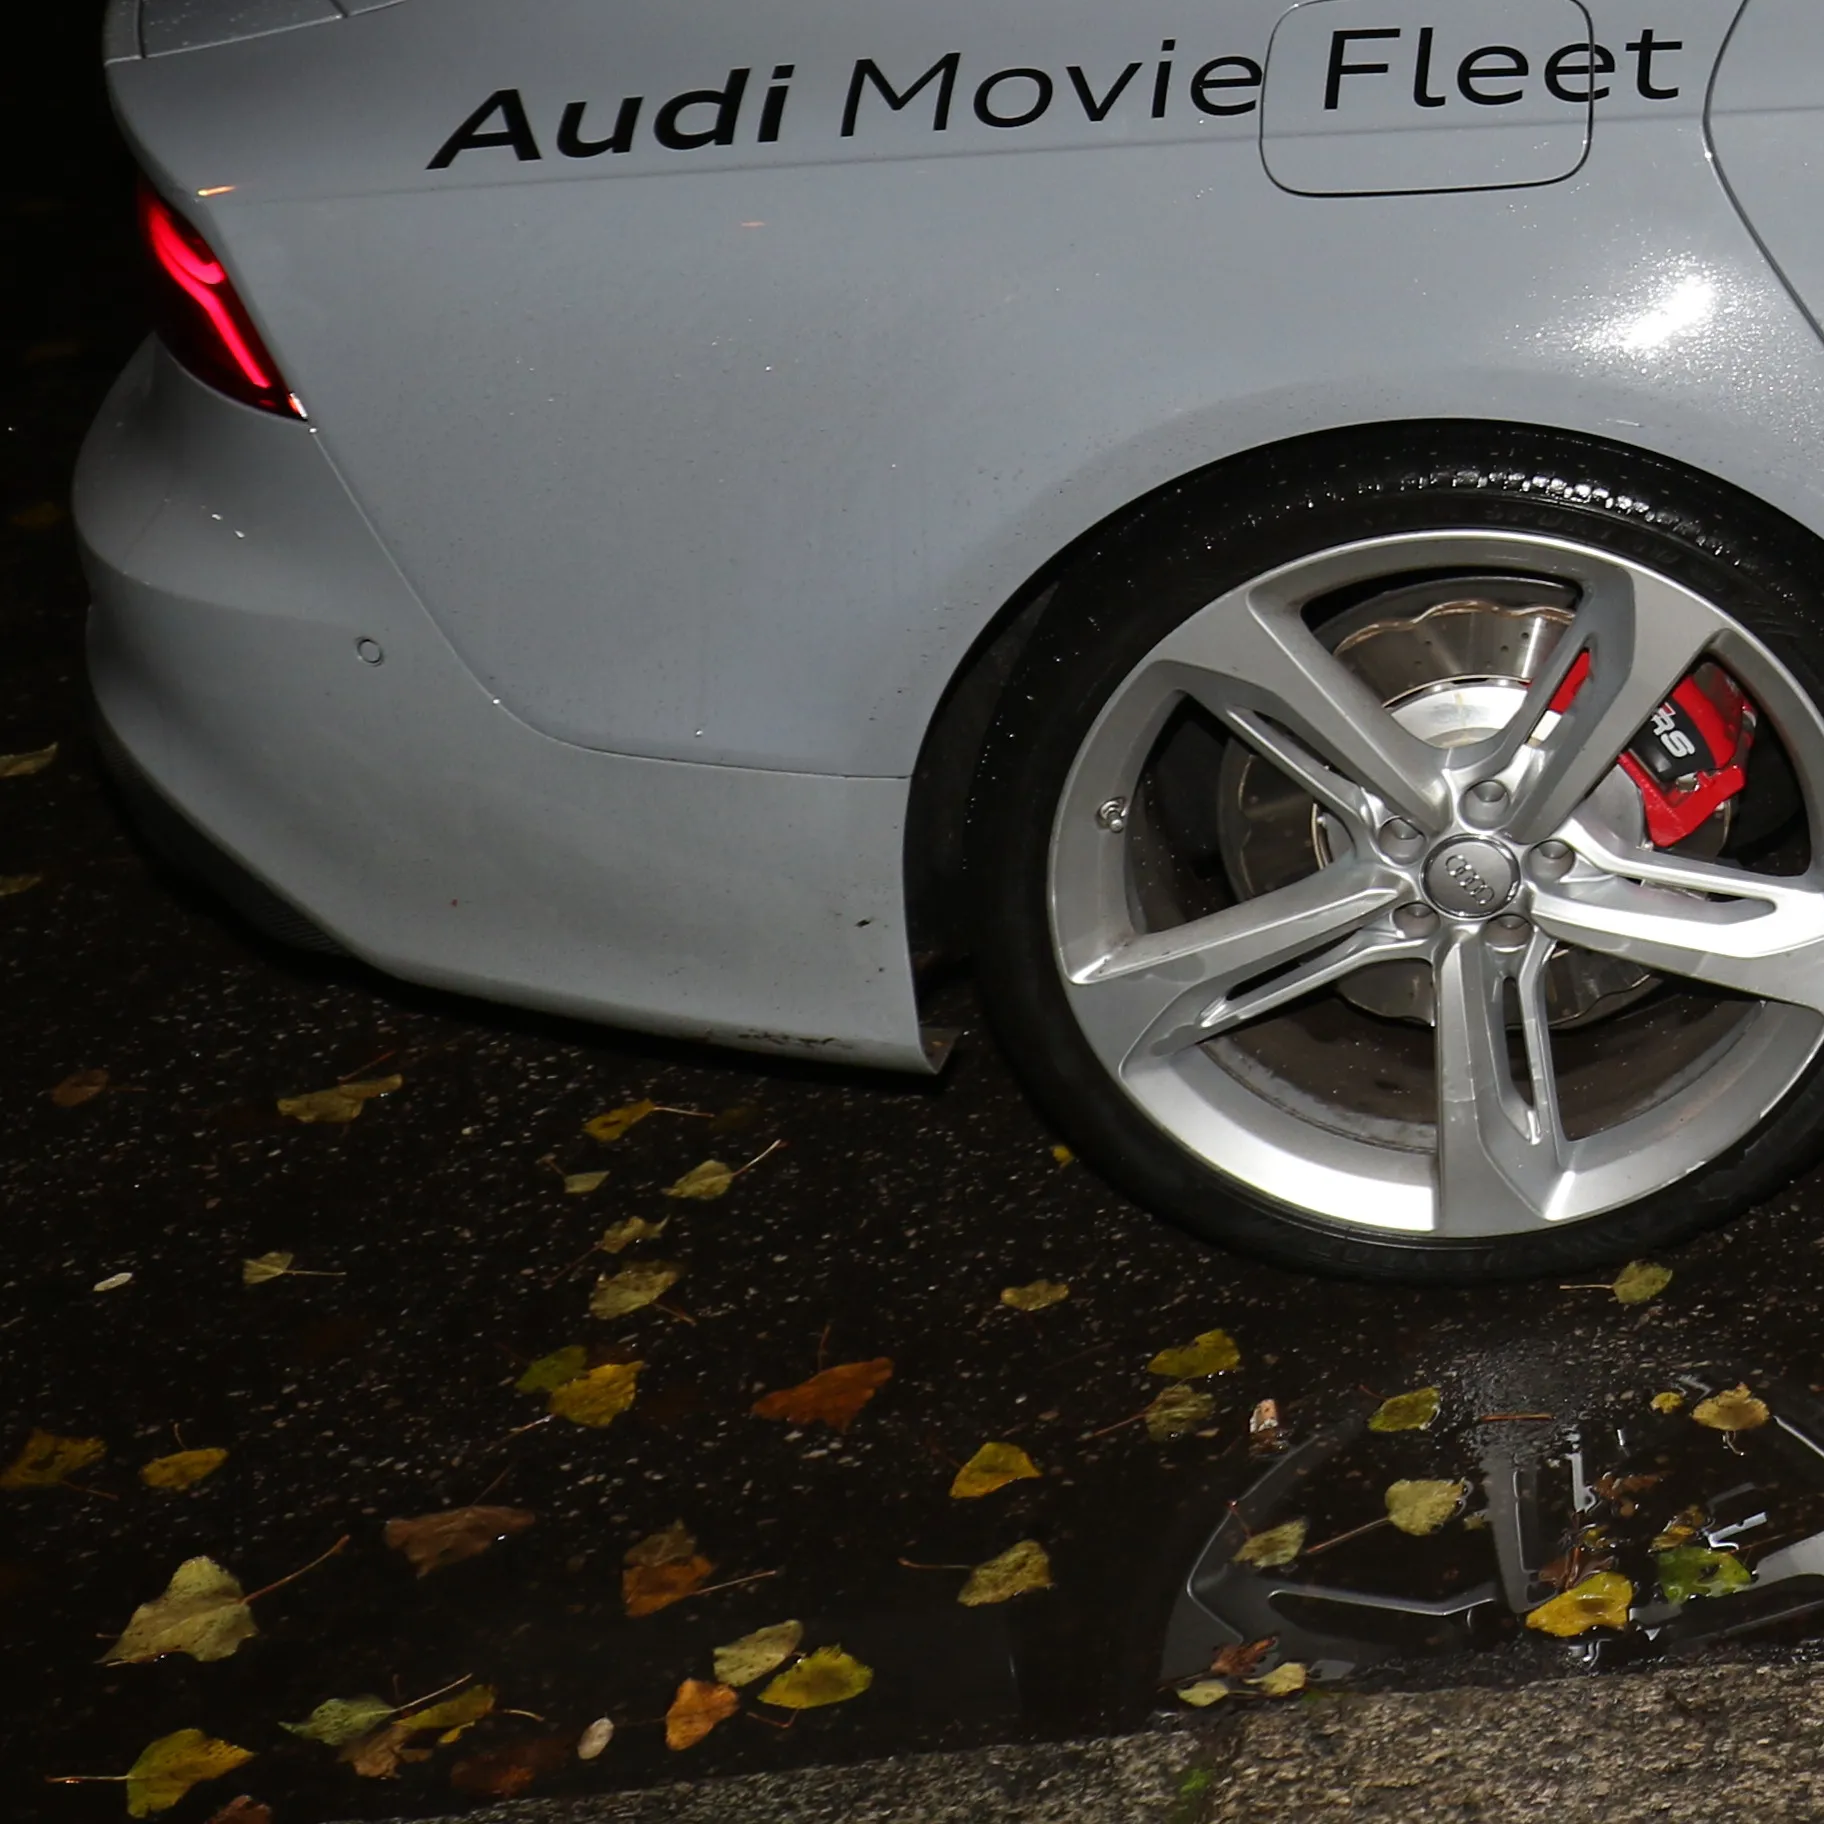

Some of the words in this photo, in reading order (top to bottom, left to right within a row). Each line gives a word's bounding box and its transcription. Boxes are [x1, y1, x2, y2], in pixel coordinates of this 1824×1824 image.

[425, 64, 796, 170] Audi
[840, 39, 1262, 138] Movie
[1324, 27, 1683, 110] Fleet
[1650, 706, 1696, 758] RS
